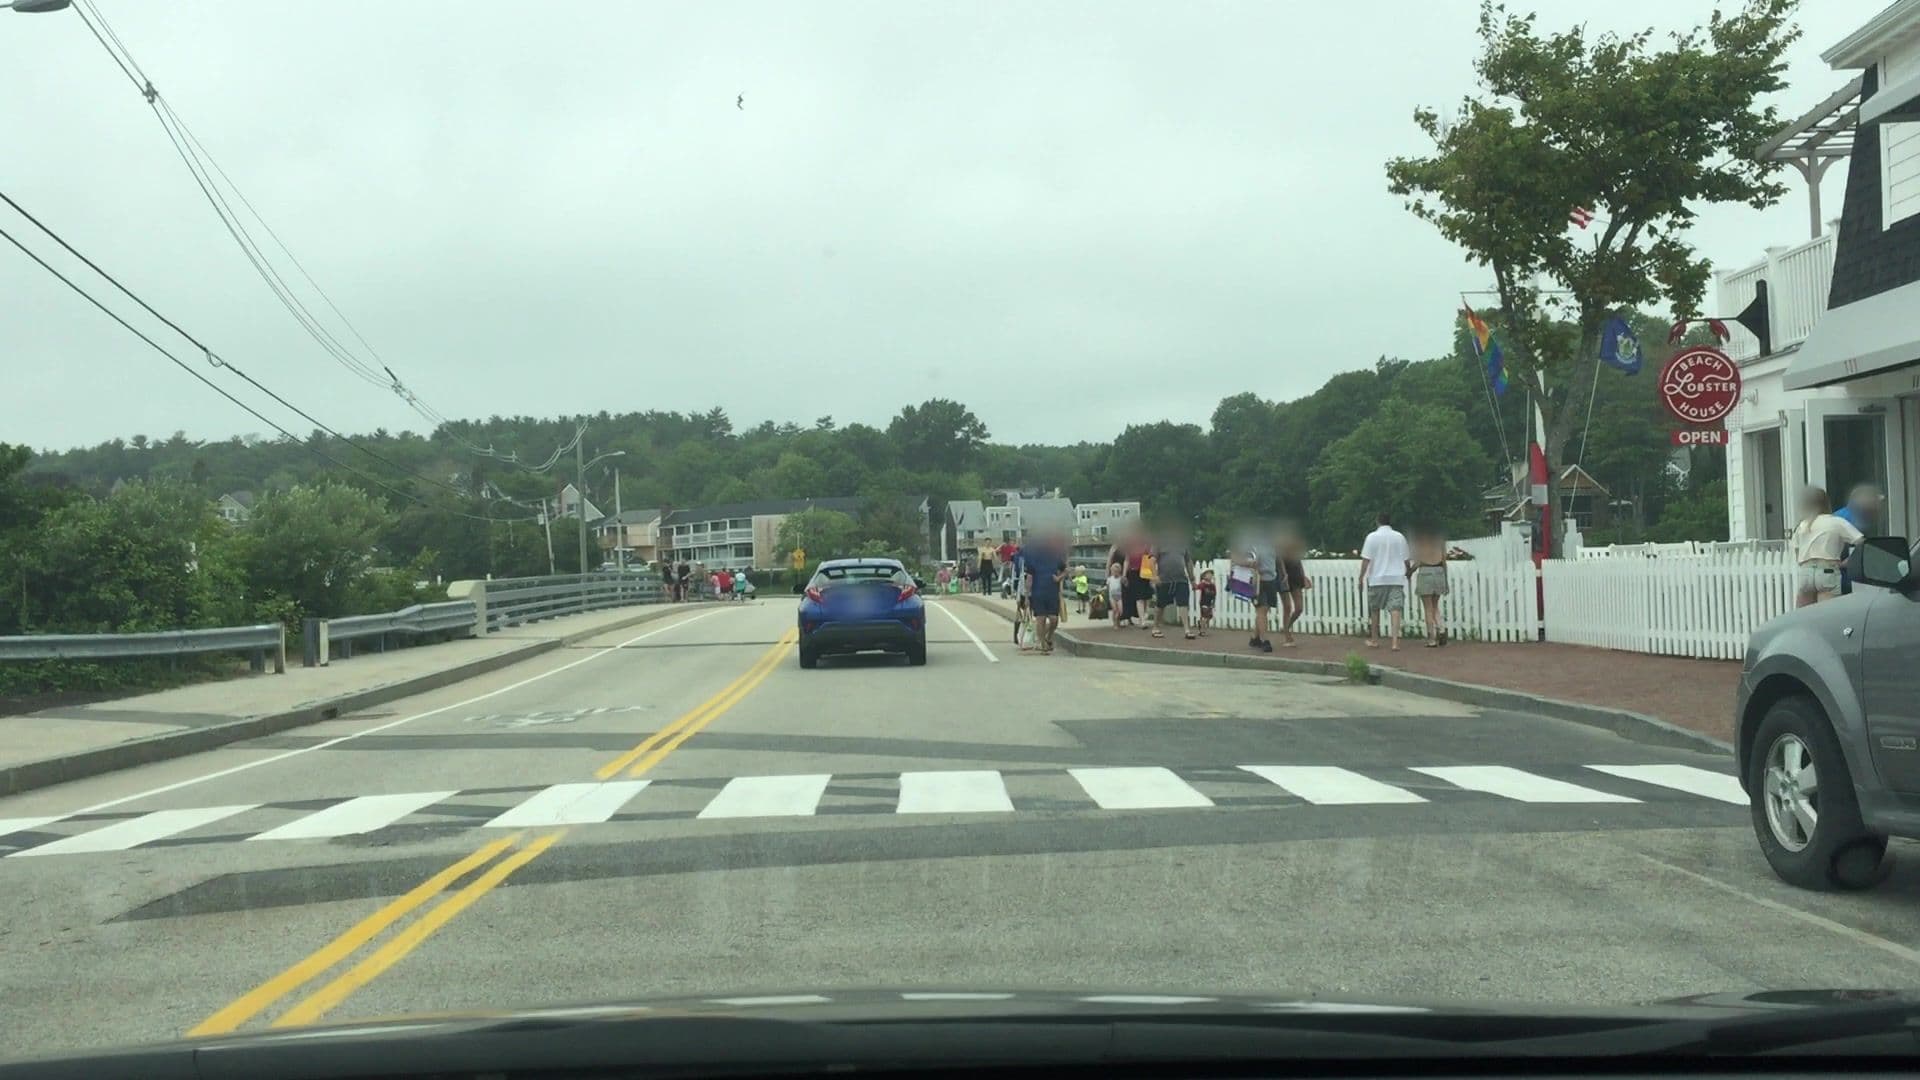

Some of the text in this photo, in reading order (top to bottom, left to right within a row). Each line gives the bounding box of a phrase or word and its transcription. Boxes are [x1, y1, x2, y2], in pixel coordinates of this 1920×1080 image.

[1679, 356, 1723, 371] BEACH
[1664, 370, 1737, 399] LOBSTER
[1679, 401, 1724, 417] HOUSE
[1679, 431, 1720, 443] OPEN
